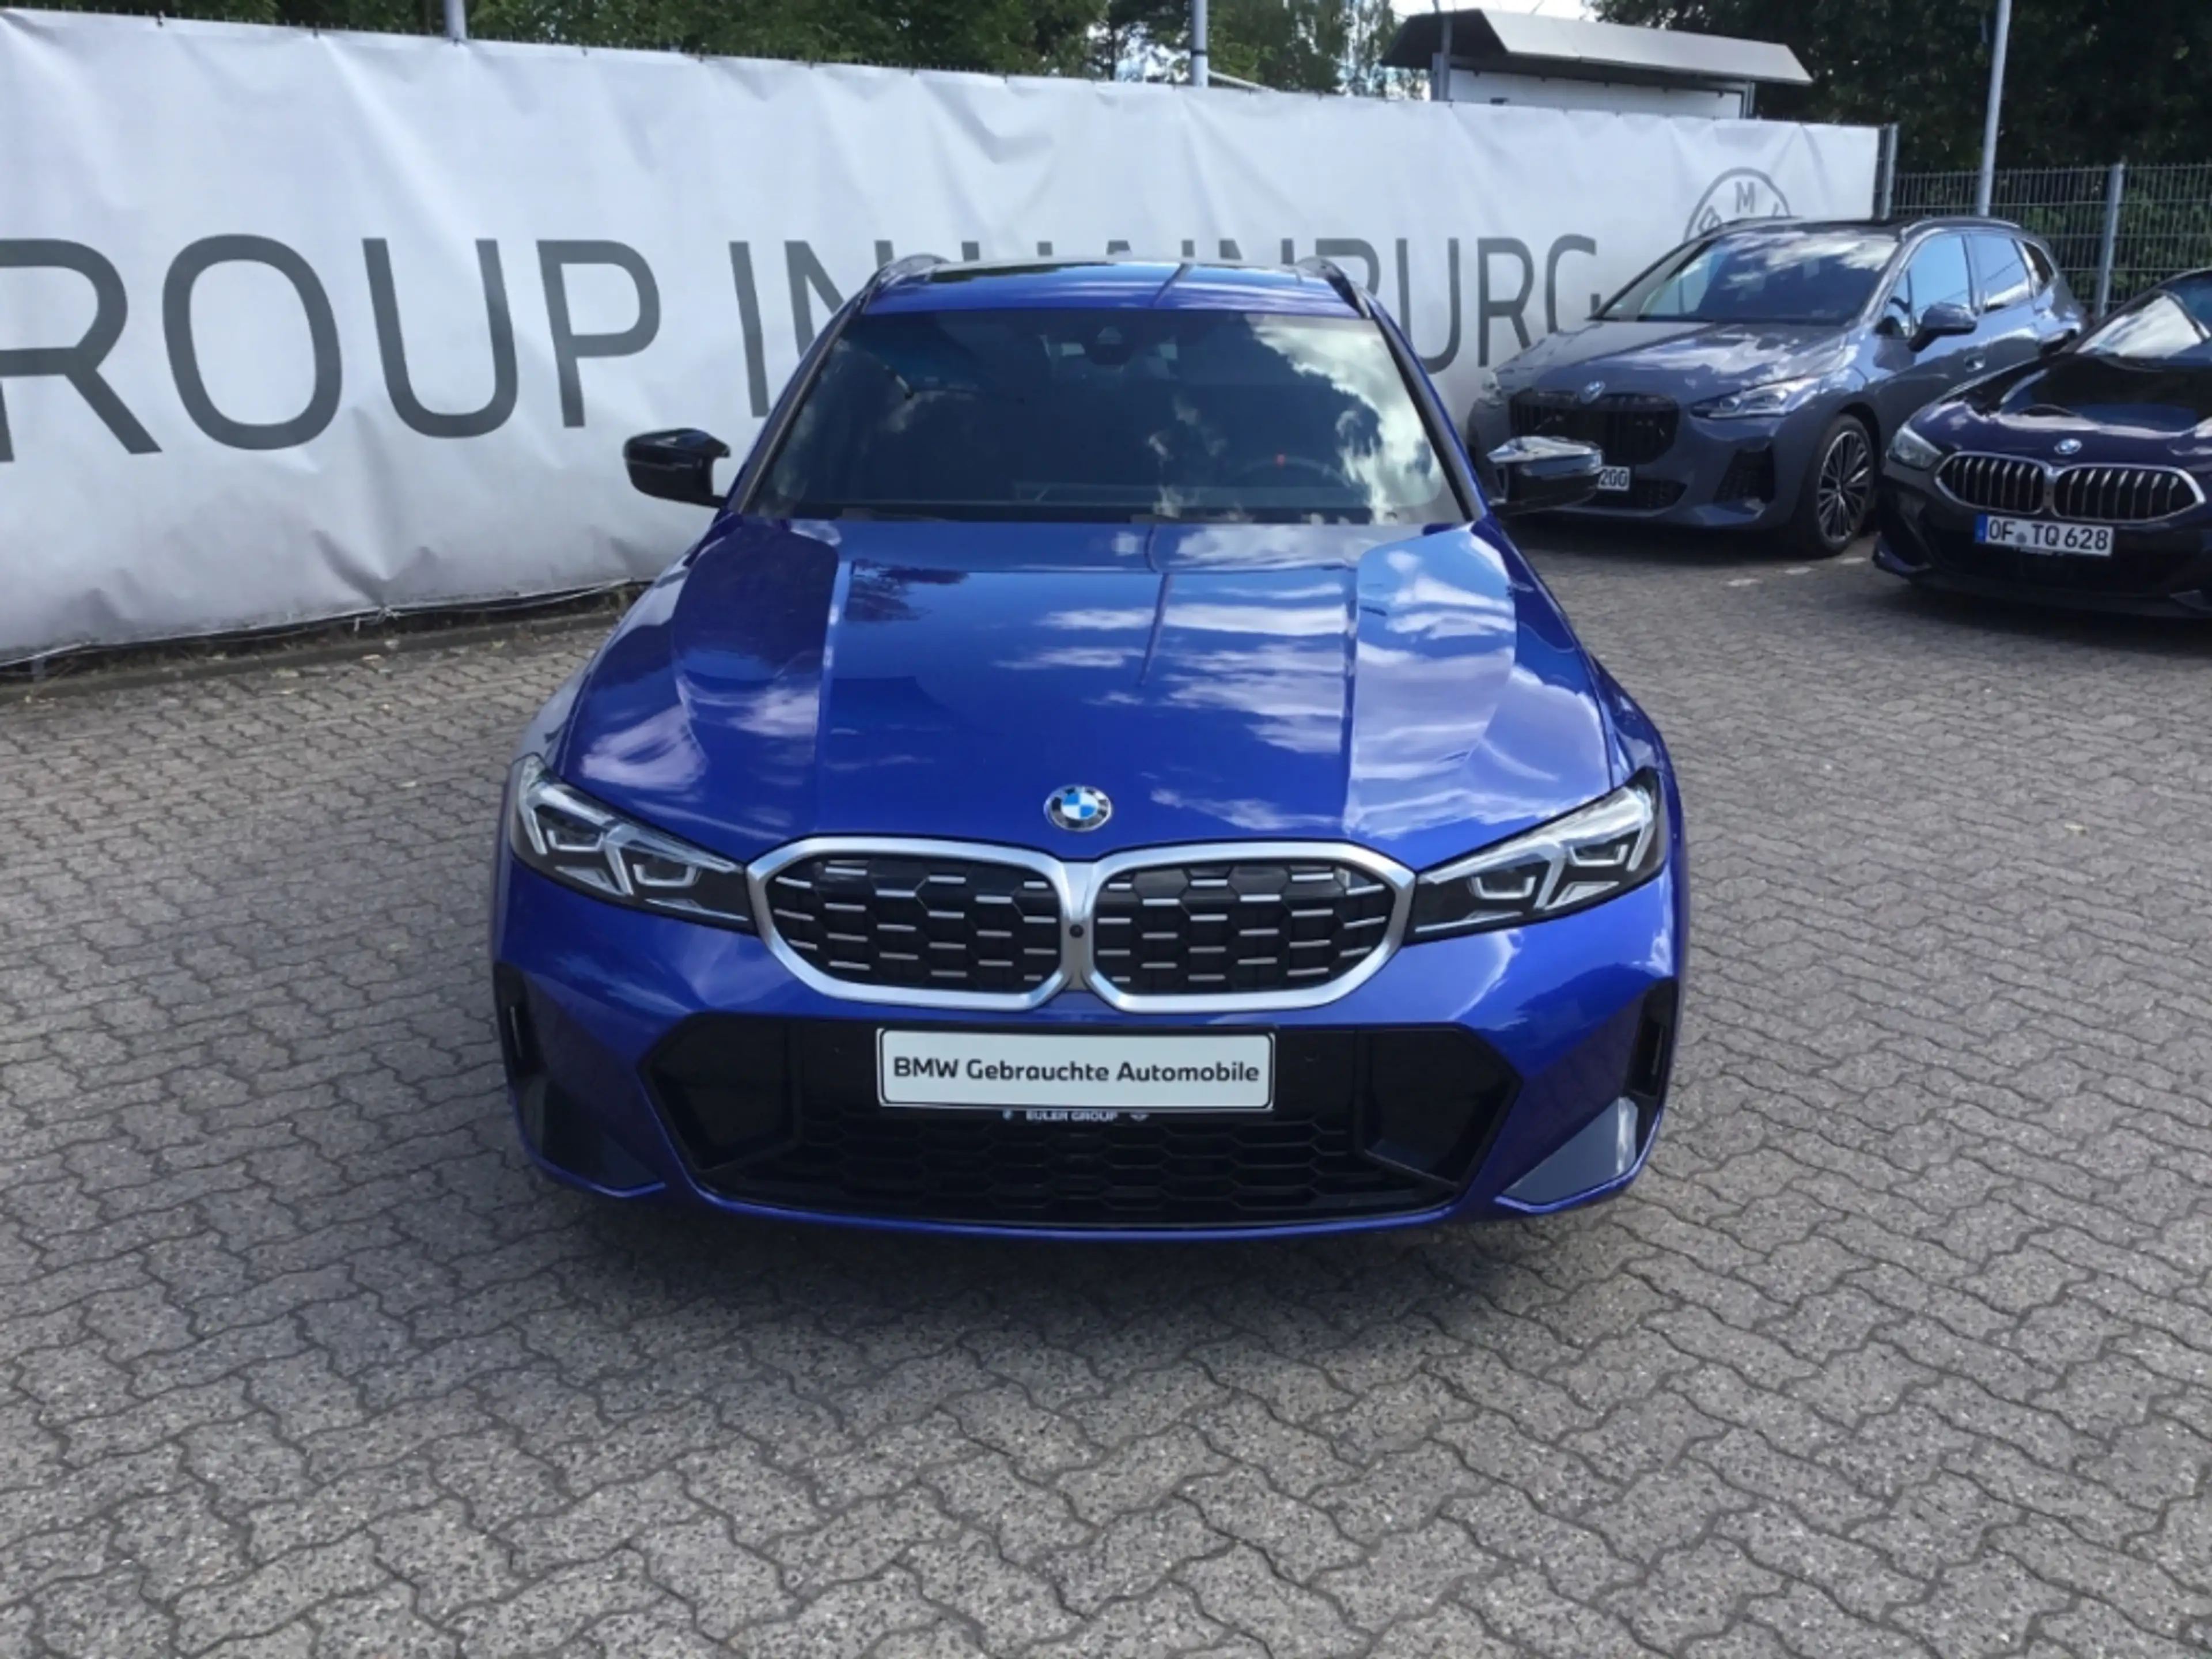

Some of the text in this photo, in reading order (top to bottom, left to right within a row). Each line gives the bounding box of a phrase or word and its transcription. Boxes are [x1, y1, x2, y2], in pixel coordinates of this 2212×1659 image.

[1989, 519, 2109, 550] OF TQ 628
[893, 1056, 1259, 1082] BMW Gebrauchte Automobile
